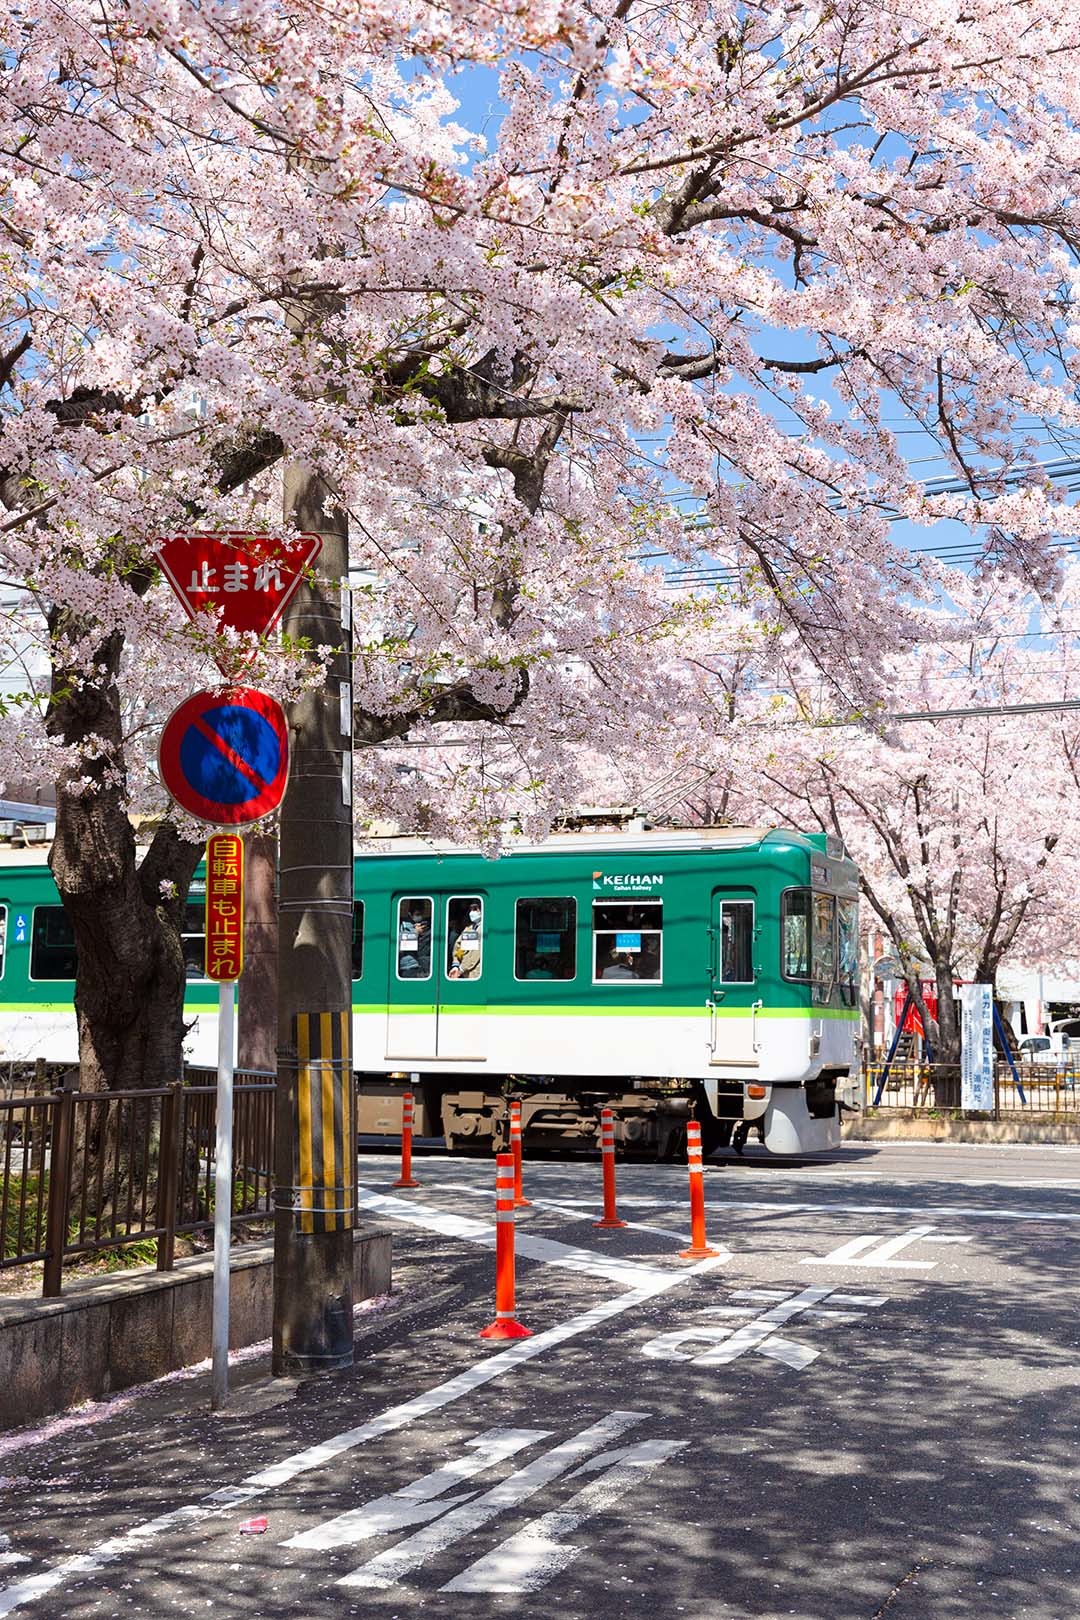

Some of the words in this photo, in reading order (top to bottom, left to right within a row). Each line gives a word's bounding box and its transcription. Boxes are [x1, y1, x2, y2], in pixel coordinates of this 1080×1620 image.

[186, 560, 286, 593] 止まれ
[211, 839, 238, 976] 自転車も止まれ
[603, 874, 663, 885] KEIHAN
[278, 1225, 974, 1594] 止まれ
